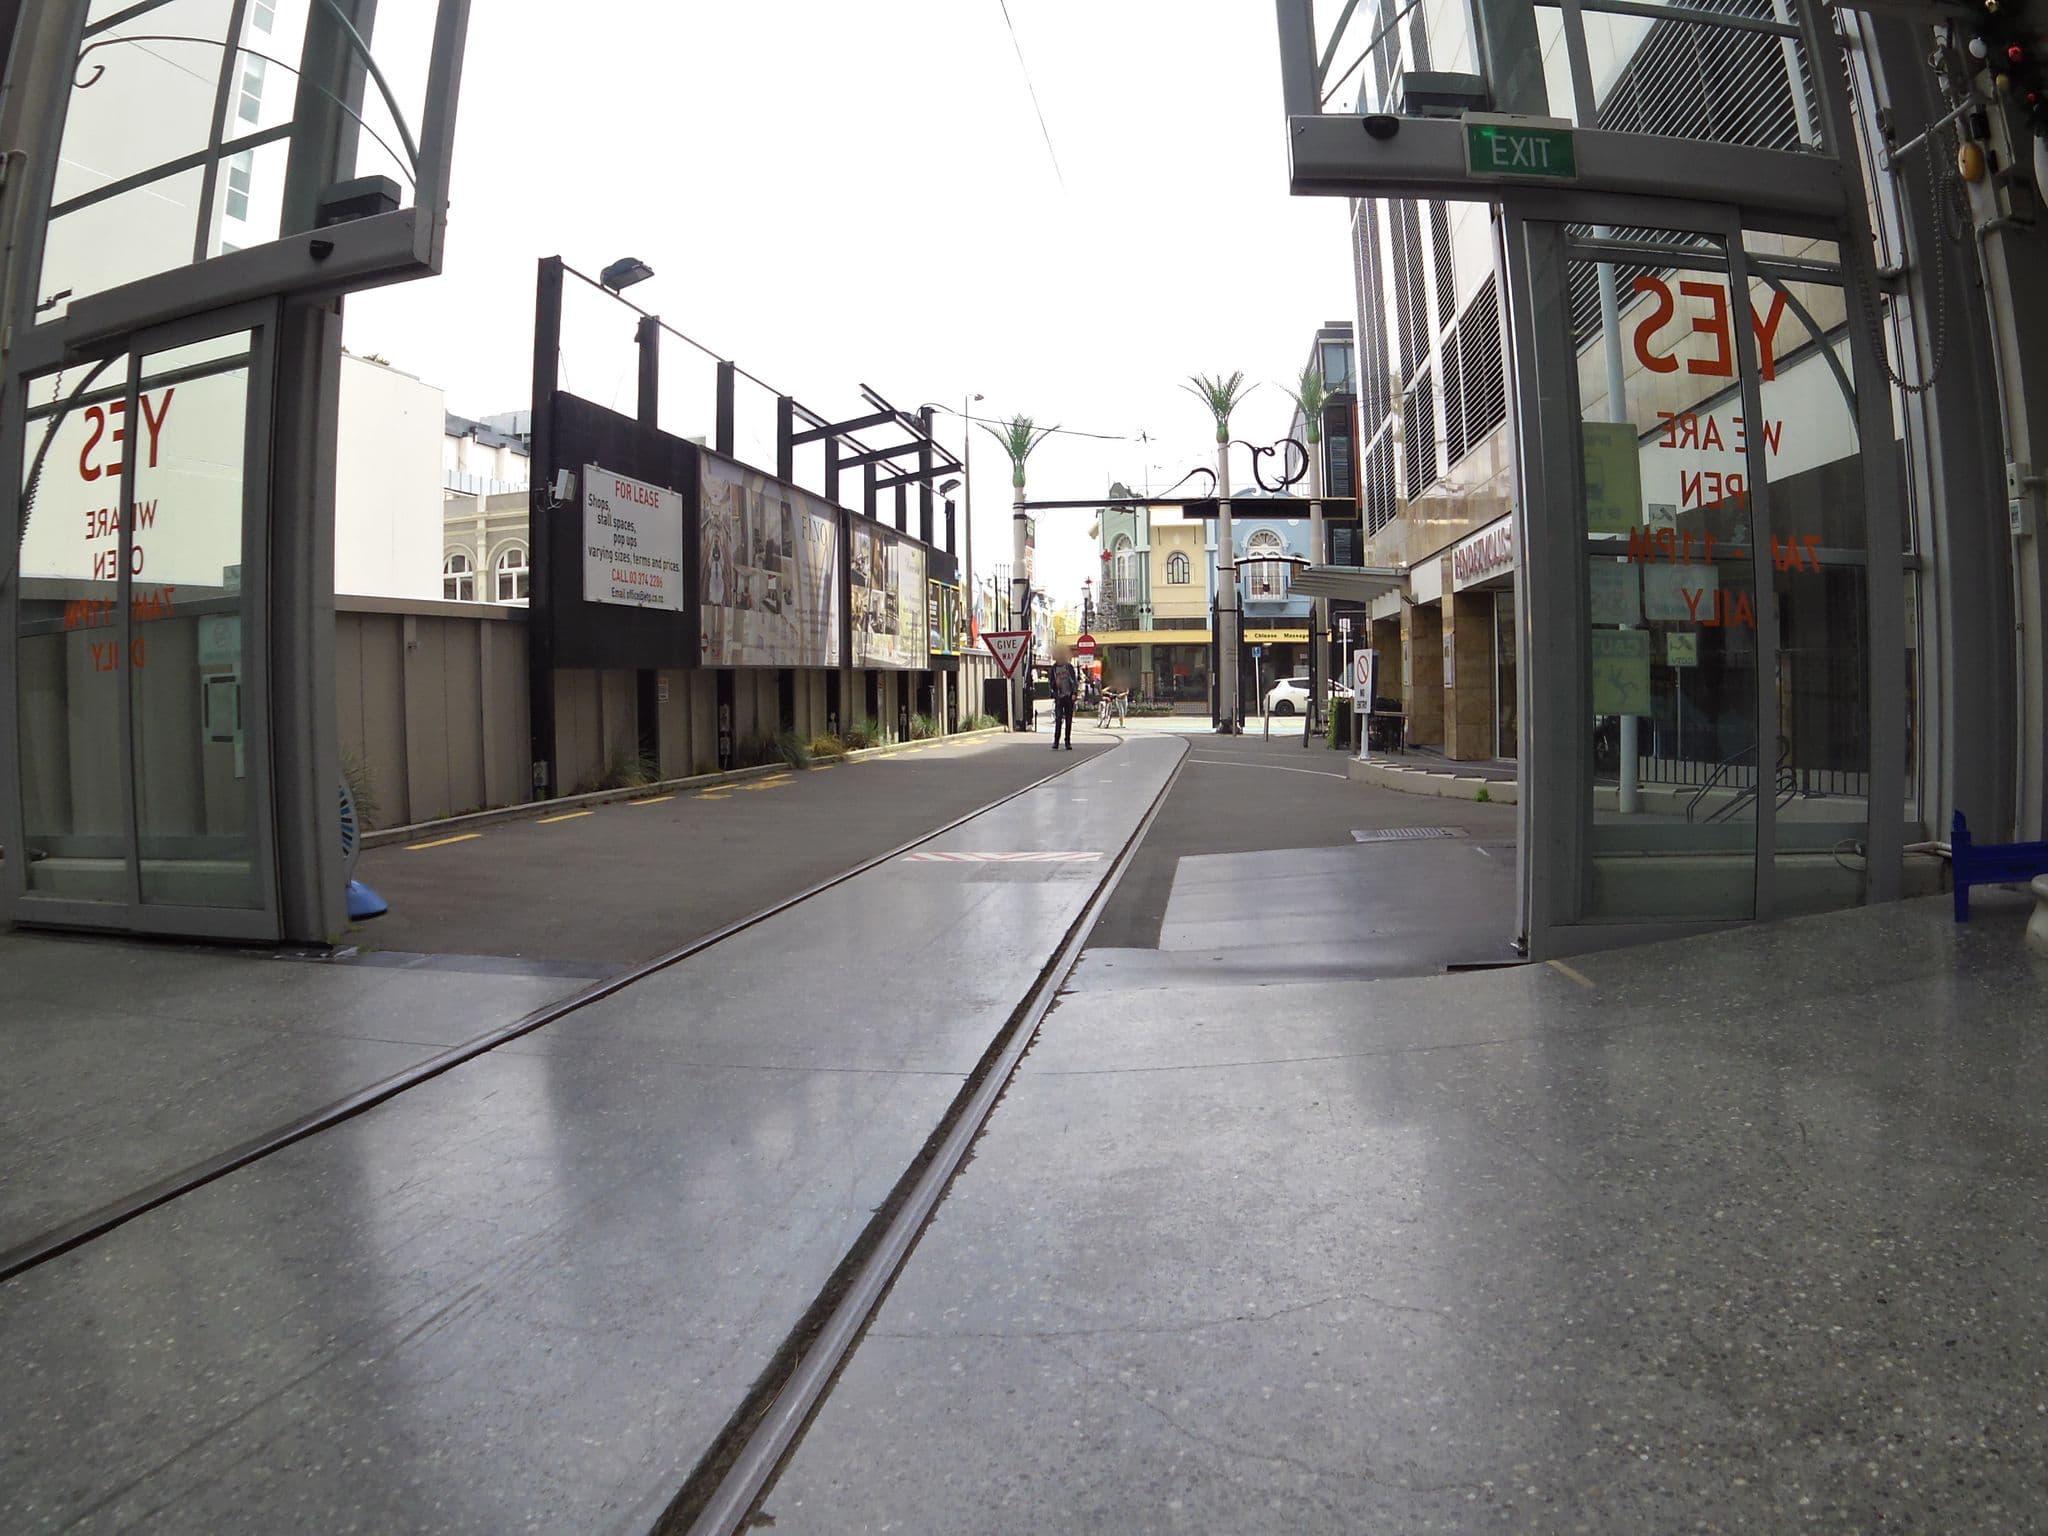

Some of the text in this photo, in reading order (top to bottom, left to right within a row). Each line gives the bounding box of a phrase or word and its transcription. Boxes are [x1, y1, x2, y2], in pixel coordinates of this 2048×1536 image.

[1492, 135, 1551, 168] EXIT
[588, 494, 611, 513] Shops,
[615, 480, 659, 509] FOR LEASE
[597, 514, 636, 534] stall spaces,
[613, 533, 637, 549] pop ups
[588, 546, 613, 563] varying
[633, 552, 651, 567] terms
[652, 556, 662, 569] and
[611, 568, 628, 583] CALL
[611, 587, 625, 599] Email
[997, 639, 1017, 650] GIVE
